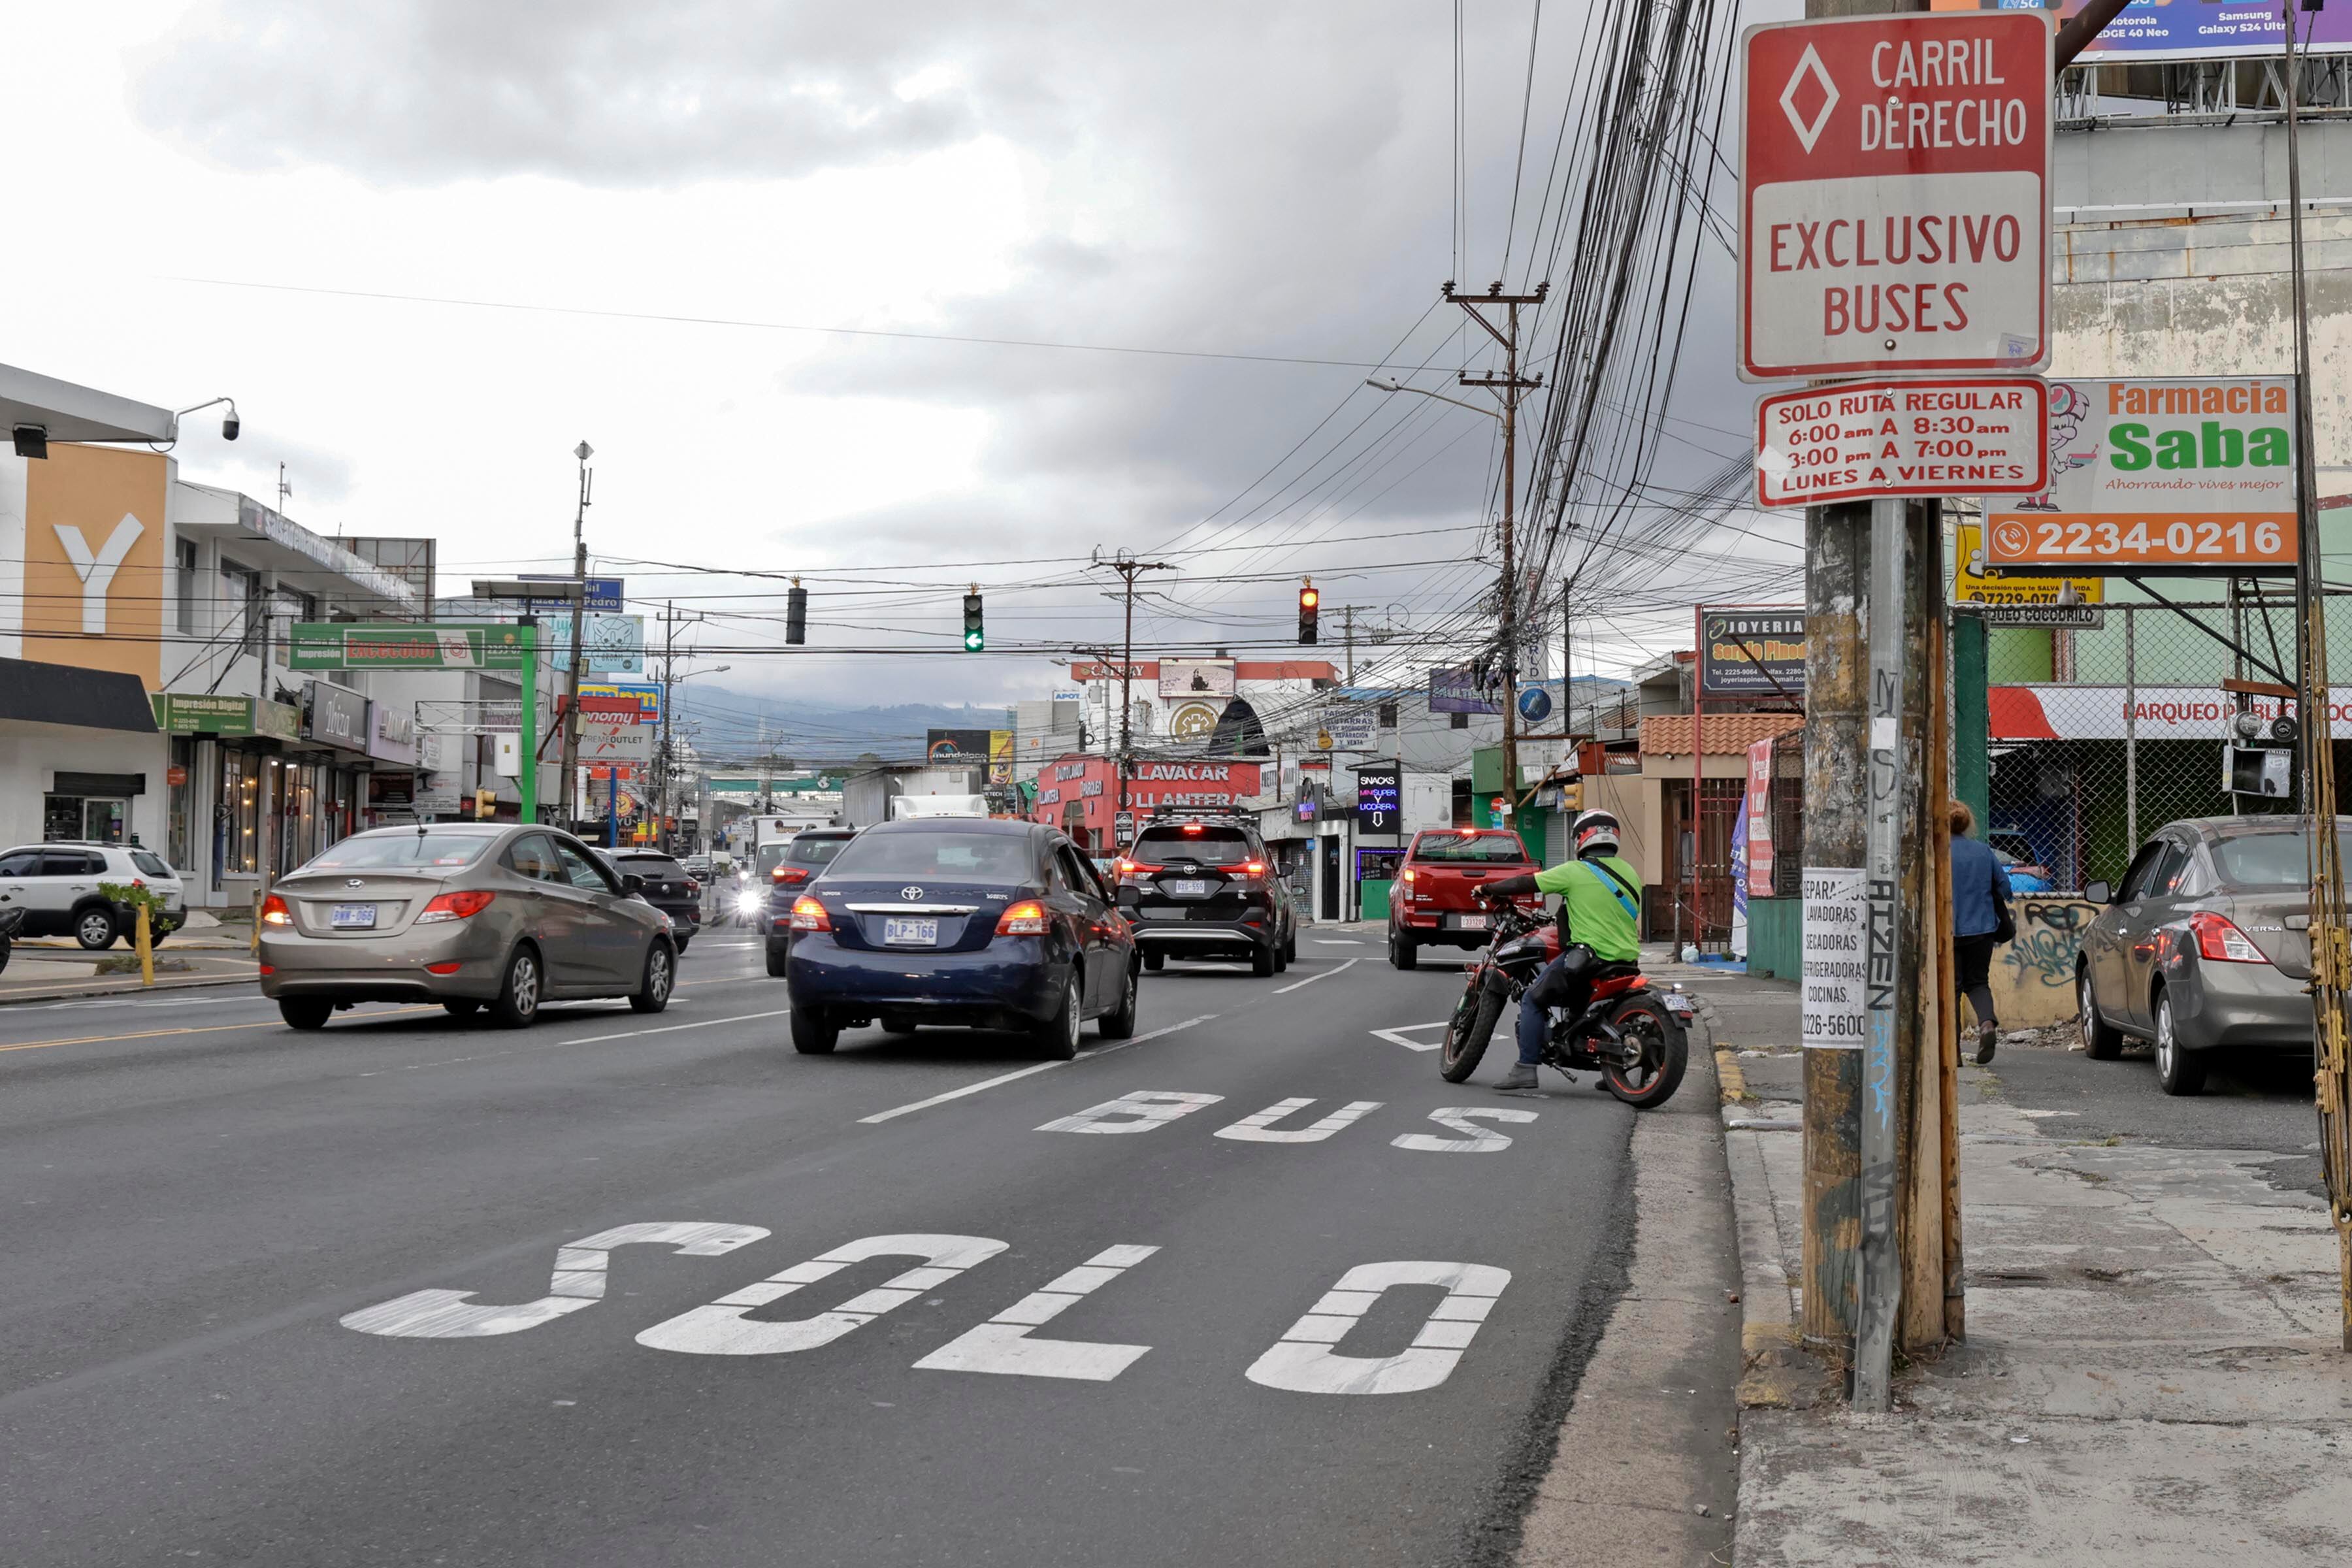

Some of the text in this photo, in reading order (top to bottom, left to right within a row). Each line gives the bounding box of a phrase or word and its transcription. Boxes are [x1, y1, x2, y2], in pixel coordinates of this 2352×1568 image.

[2198, 22, 2286, 35] Galaxy S24 Ultr
[2219, 10, 2272, 23] Samsung
[2095, 27, 2169, 39] EDGE 40 Neo
[1871, 37, 2005, 88] CARRIL
[1860, 99, 2027, 152] DERECHO
[1770, 214, 2021, 272] EXCLUSIVO
[1824, 282, 1969, 336] BUSES
[1778, 392, 2023, 425] SOLO RUTA REGULAR
[2108, 382, 2287, 415] Farmacia
[1788, 423, 1840, 446] 6:00
[1844, 426, 1873, 440] am
[1880, 418, 1899, 436] A
[1788, 446, 1838, 469] 3:00
[1845, 451, 1870, 465] pm
[1881, 441, 1899, 459] A
[2108, 421, 2291, 472] Saba
[1782, 465, 2024, 492] LUNES A VIERNES
[2105, 478, 2197, 491] Ahorrando
[2239, 479, 2283, 493] mejor
[2036, 522, 2282, 555] 2234-0216
[53, 512, 144, 634] Y
[1728, 620, 1803, 634] JOYERIA
[1712, 640, 1806, 663] Sergio Pined
[172, 698, 246, 711] Impresión Digital
[1137, 765, 1230, 781] LAVACAR
[1360, 776, 1395, 785] SNACKS
[1806, 906, 1857, 922] LAVADORAS
[887, 924, 934, 939] BLP-166
[1806, 934, 1857, 951] SECADORAS
[1808, 986, 1850, 1003] COCINAS.
[1031, 1090, 1541, 1152] BUS
[340, 1220, 1513, 1396] SOLO
